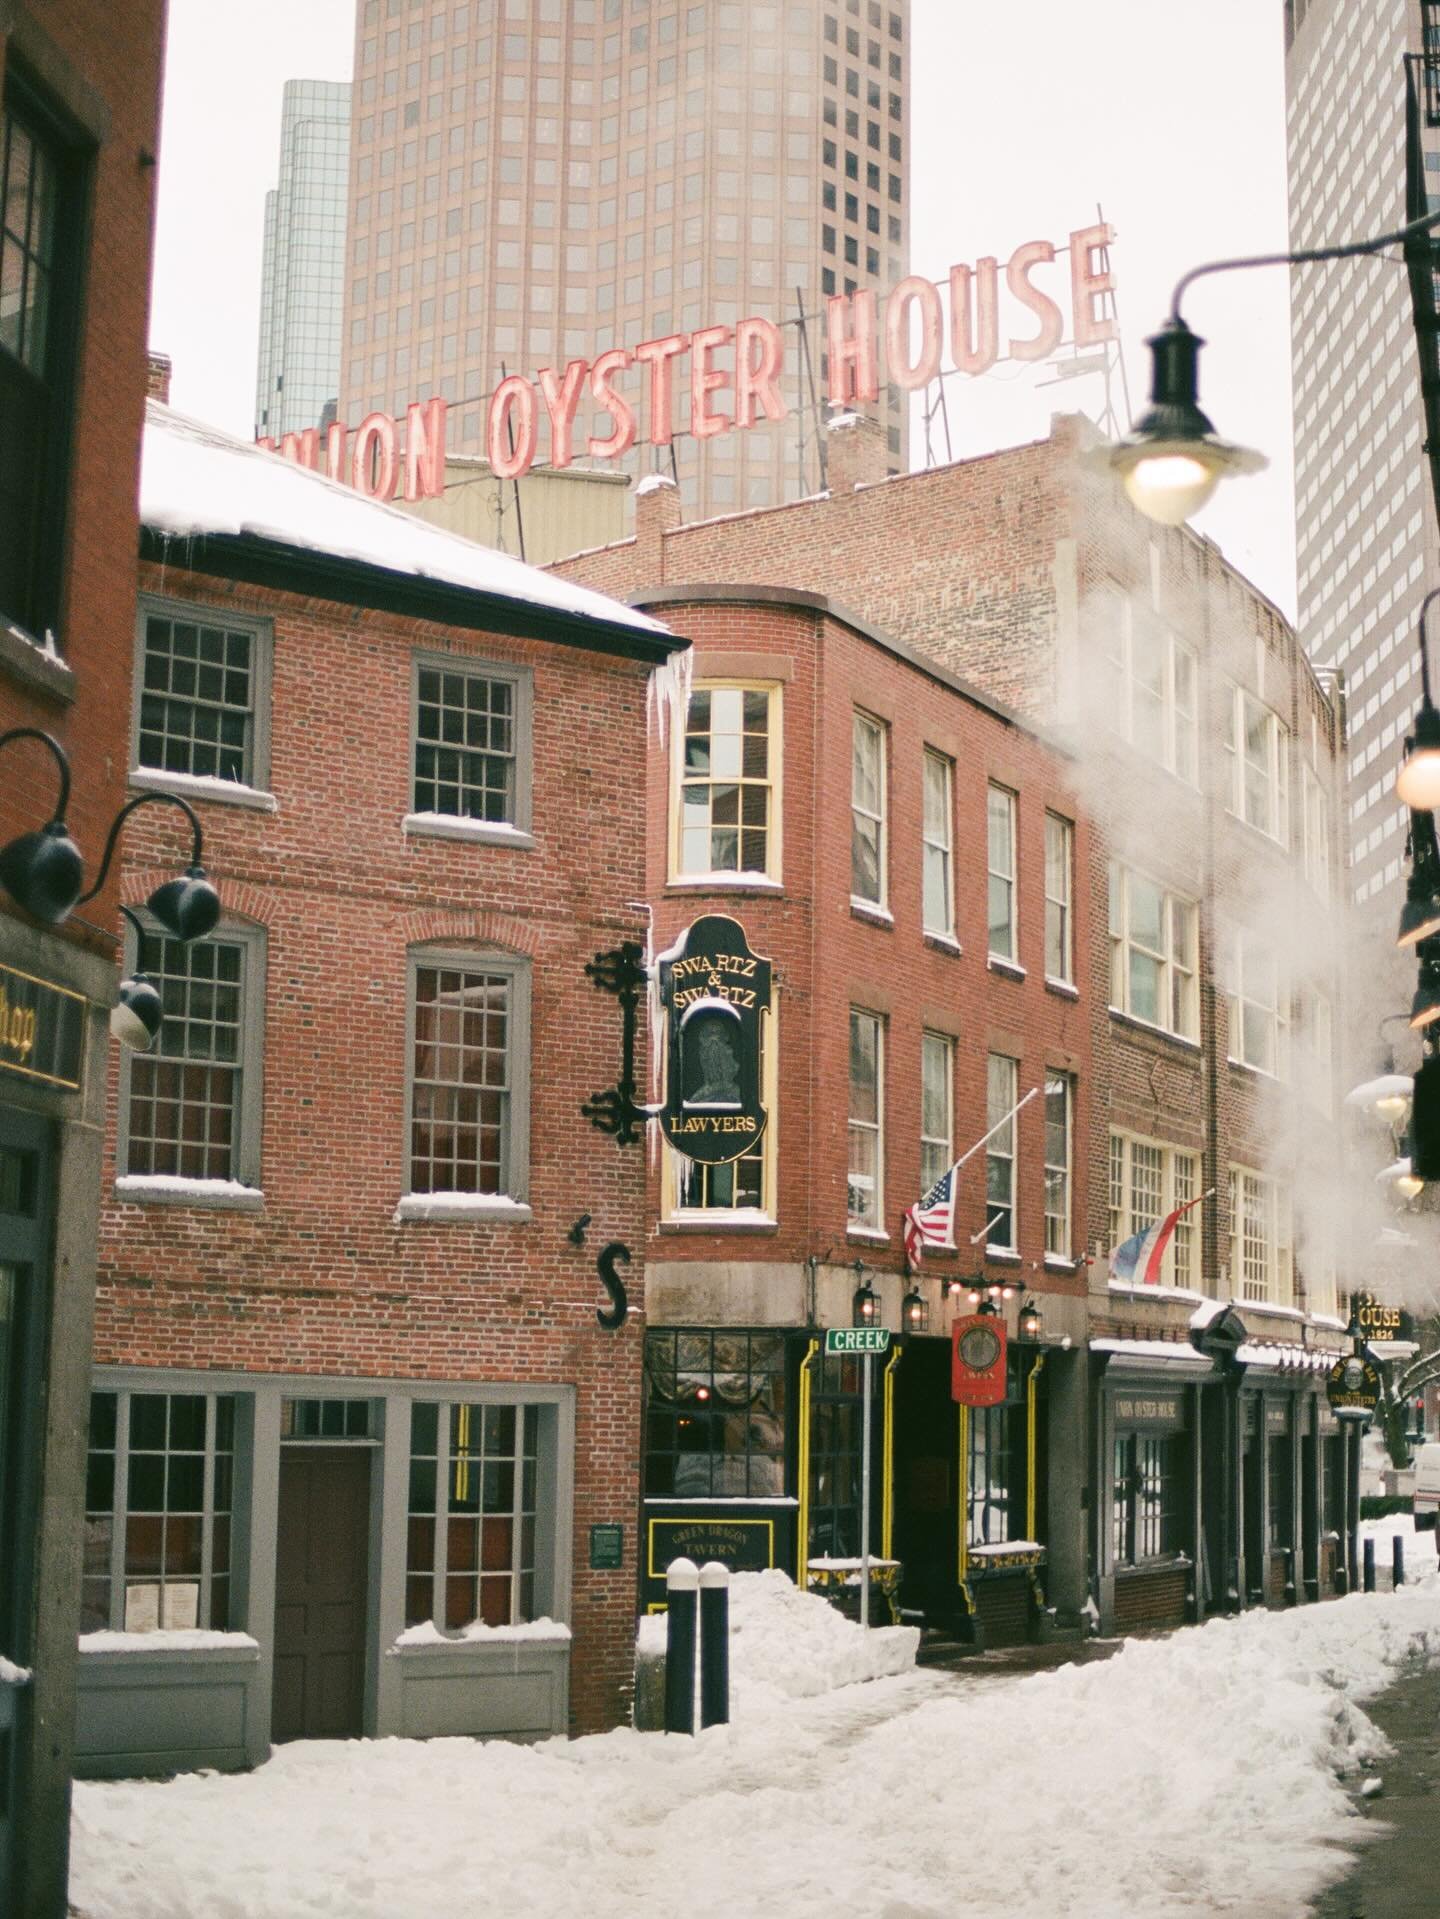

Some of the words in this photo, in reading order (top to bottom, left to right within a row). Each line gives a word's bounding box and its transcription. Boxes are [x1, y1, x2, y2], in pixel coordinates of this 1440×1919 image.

[257, 397, 448, 503] ION
[488, 317, 785, 480] OYSTER
[827, 223, 1119, 403] HOUSE
[671, 954, 758, 979] SWARTZ
[708, 970, 721, 986] &
[672, 985, 758, 1008] SWARTZ
[670, 1116, 756, 1133] LAWYERS
[1358, 1307, 1400, 1327] OUSE
[834, 1331, 884, 1349] CREEK
[672, 1526, 705, 1544] GREEN
[685, 1544, 737, 1556] TAVERN
